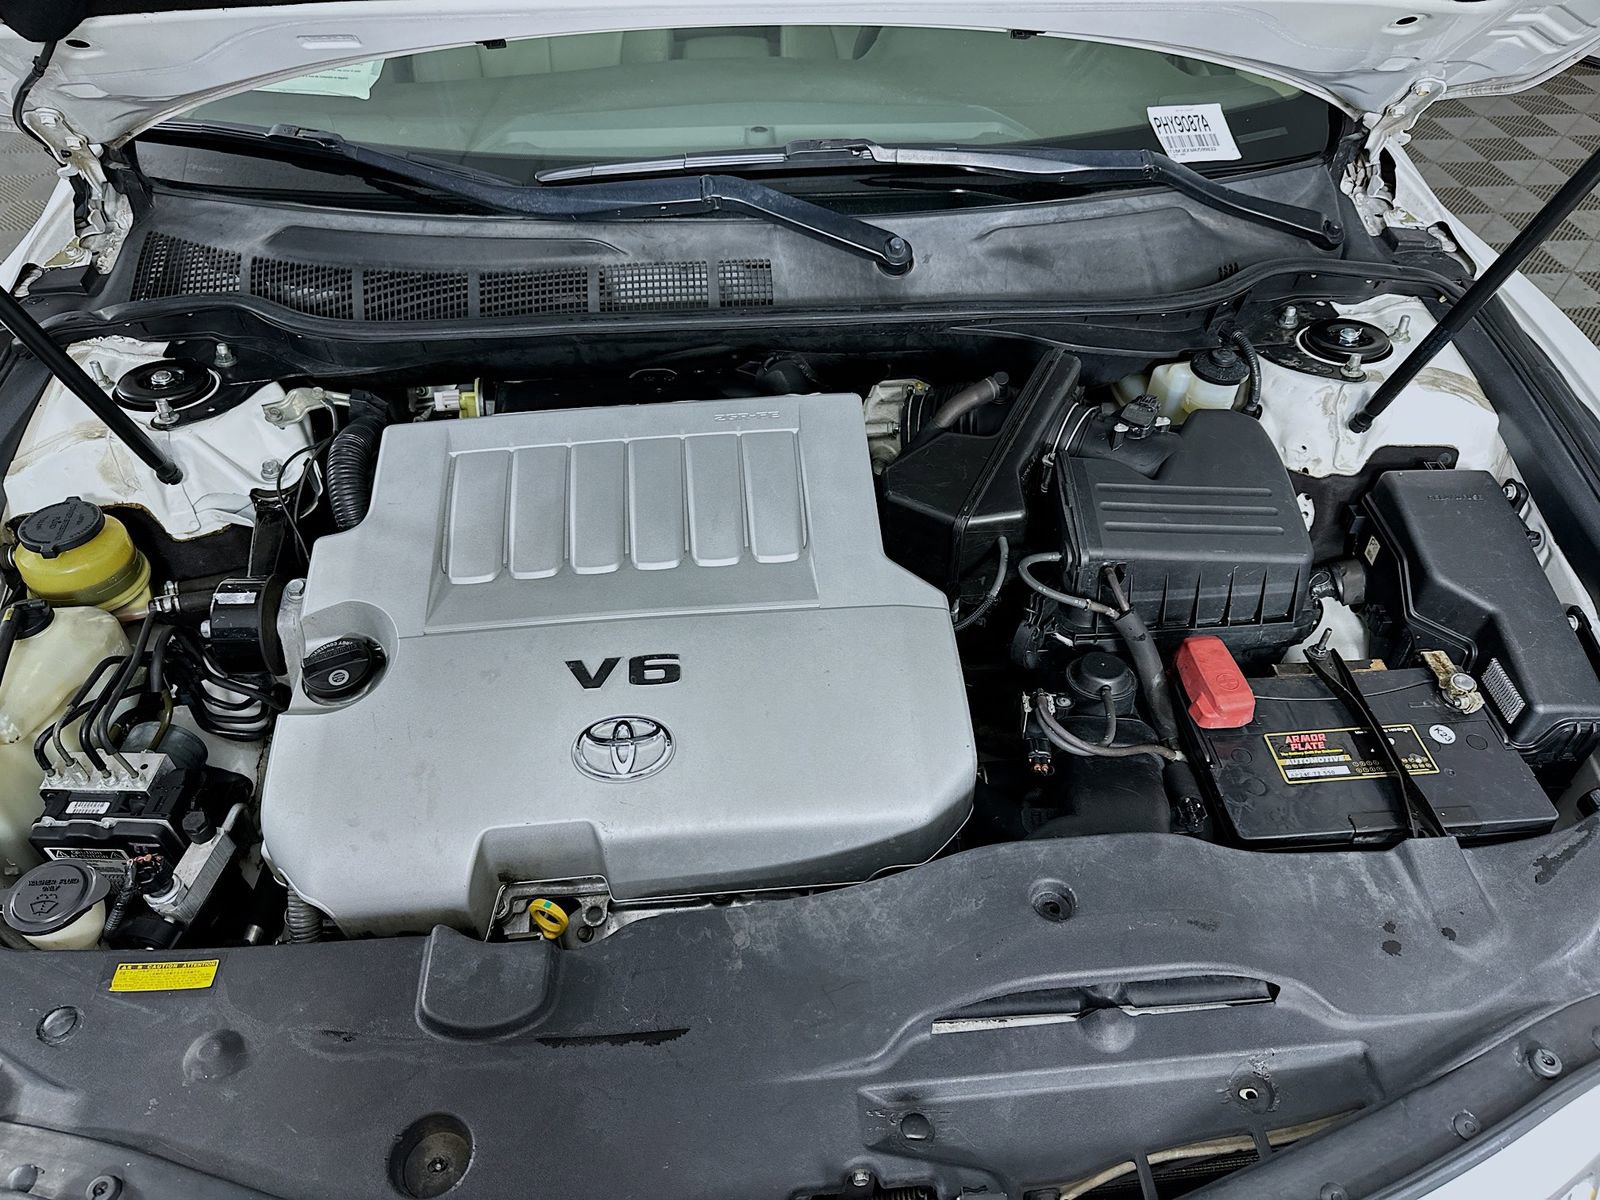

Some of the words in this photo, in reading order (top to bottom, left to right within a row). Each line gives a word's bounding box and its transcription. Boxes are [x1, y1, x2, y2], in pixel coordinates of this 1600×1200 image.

[1153, 114, 1212, 134] PHY9087A
[564, 653, 681, 689] V6
[1285, 733, 1327, 744] ARMOR
[1290, 741, 1325, 751] PLATE
[1286, 755, 1345, 765] AUTOMOTIVE
